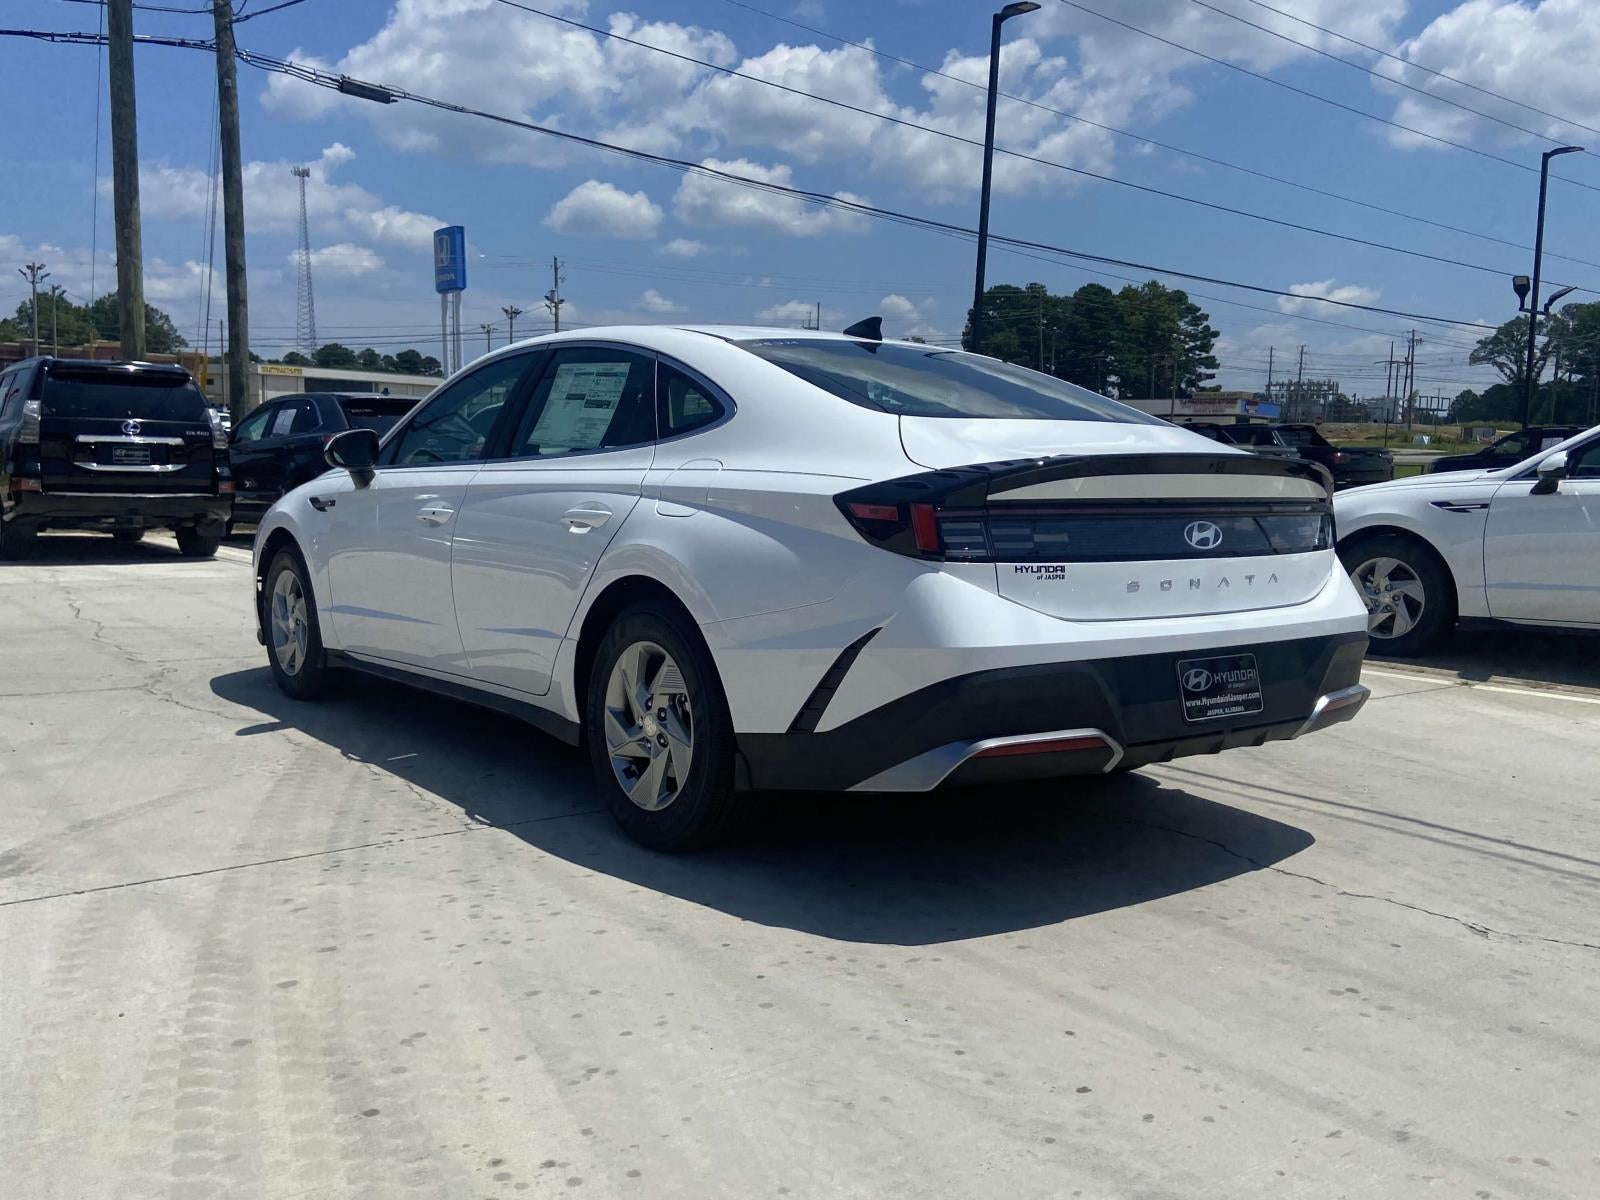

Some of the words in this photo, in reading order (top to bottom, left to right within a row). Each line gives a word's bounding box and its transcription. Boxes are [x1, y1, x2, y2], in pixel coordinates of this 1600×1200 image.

[1015, 565, 1066, 573] HYUNDAI
[1126, 573, 1278, 593] SONATA
[1213, 669, 1257, 683] HYUNDAI
